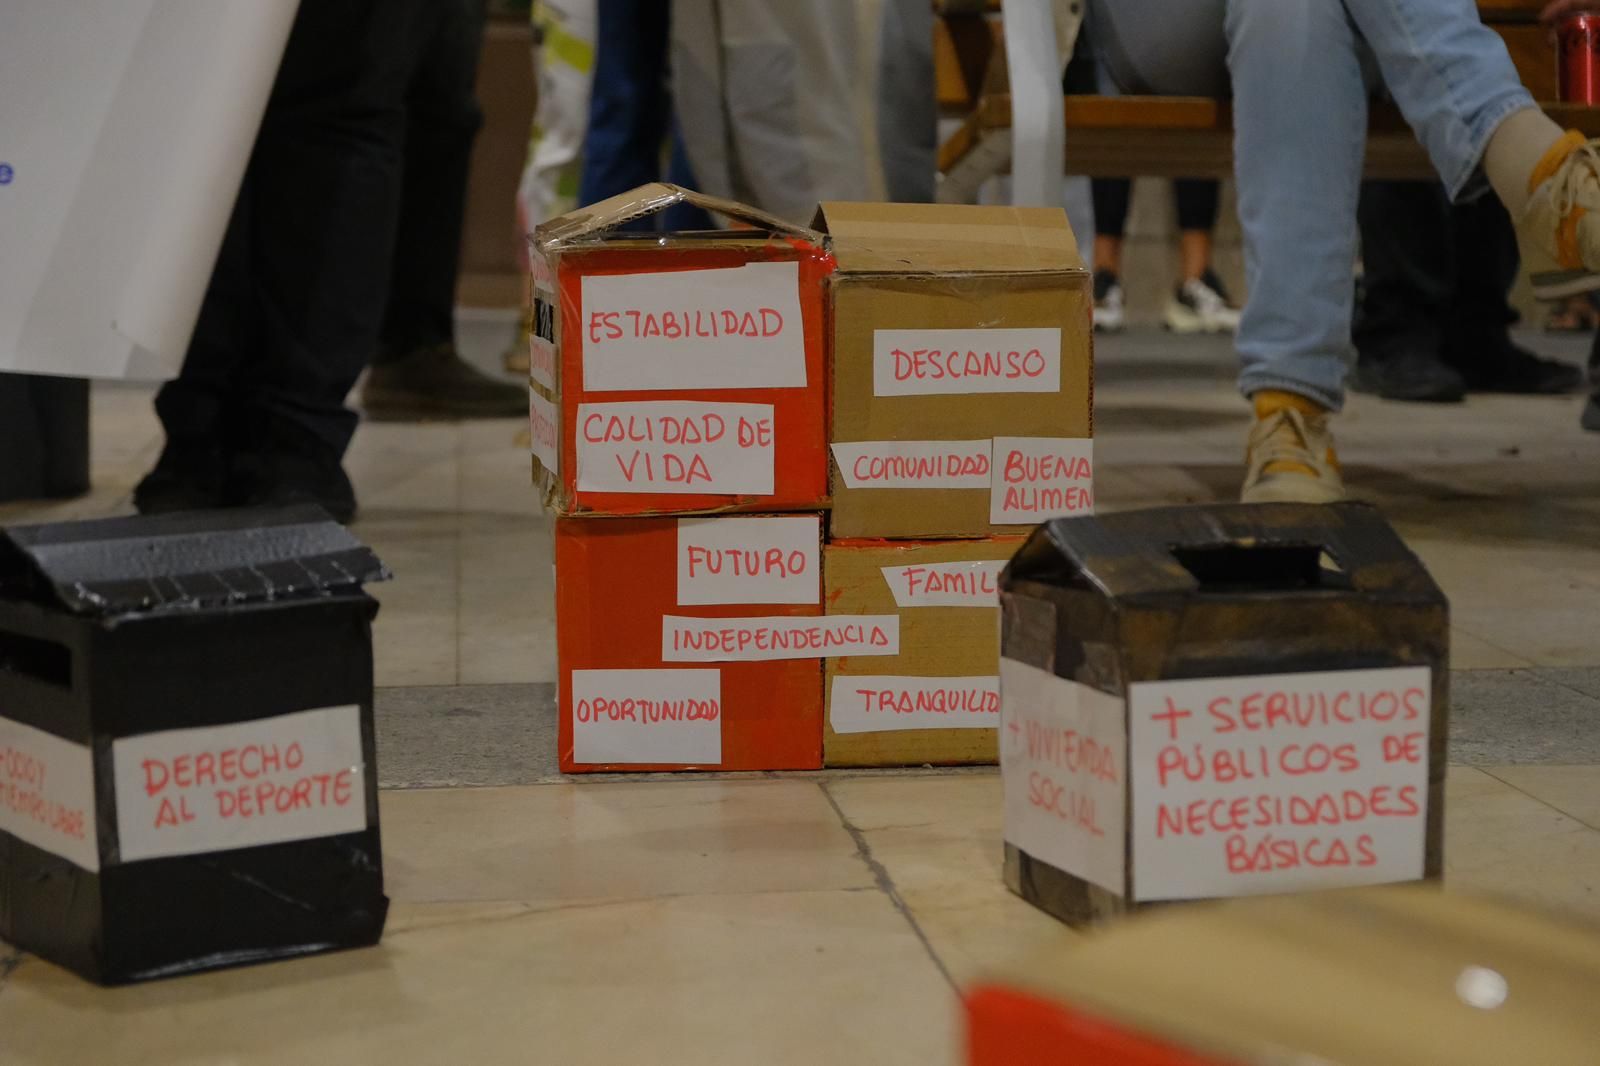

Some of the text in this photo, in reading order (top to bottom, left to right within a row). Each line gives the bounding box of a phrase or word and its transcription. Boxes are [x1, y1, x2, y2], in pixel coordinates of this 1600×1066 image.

[589, 308, 783, 343] ESTABILIDAD
[890, 348, 1046, 380] DESCANSO
[583, 412, 771, 448] CALIDAD DE
[615, 450, 713, 484] VIDA
[853, 453, 990, 481] COMUNIDAD
[1003, 450, 1092, 483] BUENA
[1003, 486, 1092, 513] ALIMEN
[687, 544, 807, 579] FUTURO
[902, 566, 1000, 596] FAMIL
[673, 624, 889, 653] INDEPENDENCIA
[576, 697, 719, 725] OPORTUNIDAD
[856, 688, 1000, 714] TRANQUILID
[1207, 688, 1426, 734] SERVICIOS
[141, 741, 304, 797] DERECHO
[1025, 719, 1118, 784] VIVIENDA
[1156, 731, 1425, 787] PÚBLICOS DE
[154, 769, 352, 829] AL DEPORTE
[1027, 769, 1105, 838] SOCIAL
[1156, 785, 1420, 839] NECESIDADES
[1224, 832, 1377, 874] BÁSICAS
